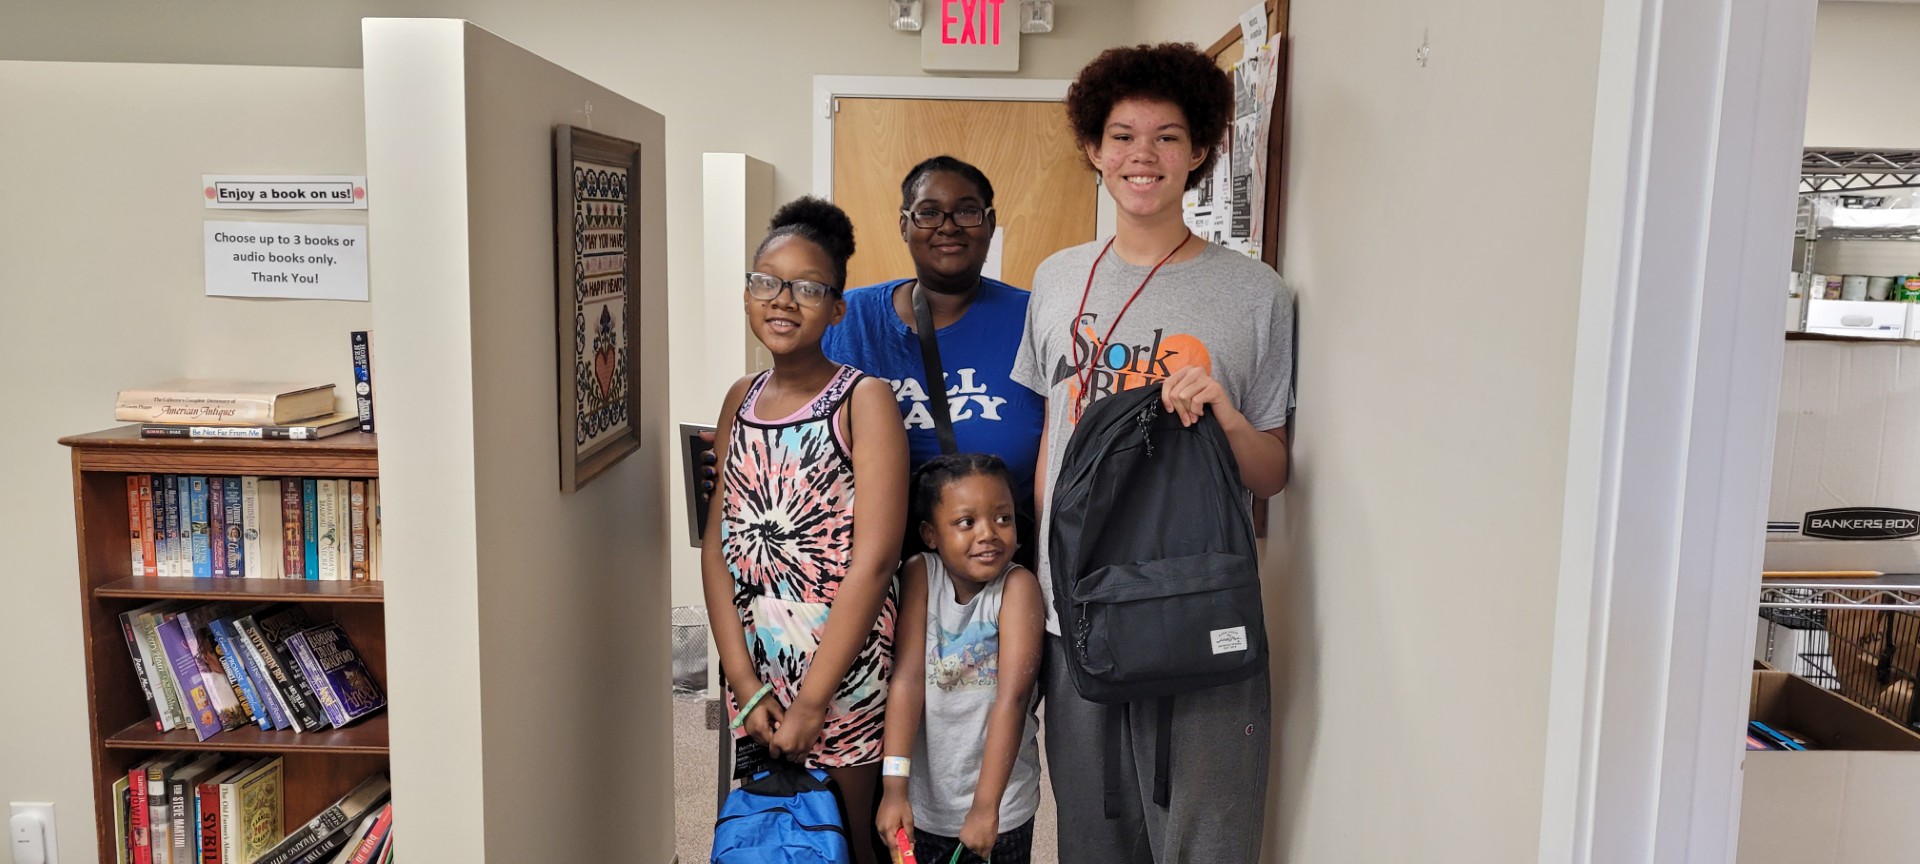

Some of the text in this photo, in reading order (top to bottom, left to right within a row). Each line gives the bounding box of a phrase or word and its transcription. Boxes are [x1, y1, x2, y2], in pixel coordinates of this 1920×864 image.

[941, 0, 1004, 45] EXIT
[219, 188, 351, 201] Enjoy a book on us!
[214, 232, 355, 247] Choose up to 3 books or
[584, 233, 623, 250] MAY YOU HAVE
[233, 251, 337, 267] audio books only.
[251, 272, 319, 284] Thank You!
[583, 277, 623, 298] A HAPPY HEART
[1064, 313, 1179, 377] Stork
[153, 405, 236, 422] American Antiques
[192, 428, 201, 436] Be
[229, 429, 248, 437] From
[248, 429, 260, 437] Me
[1810, 518, 1915, 530] BANKERS BOX
[144, 628, 159, 651] Merry
[307, 630, 339, 649] BARBARA
[247, 626, 280, 673] STUTTERIN'
[271, 667, 288, 683] BOY
[313, 643, 338, 660] TAYLOR
[320, 649, 355, 671] BRADFORD
[133, 657, 143, 676] Dear
[226, 655, 244, 682] PROMISE
[341, 676, 379, 714] Angel
[130, 788, 141, 827] down
[172, 796, 185, 848] STEVE MARTINI
[222, 813, 230, 840] Farmer's
[203, 812, 218, 861] SYBIL
[287, 833, 317, 856] WALKING
